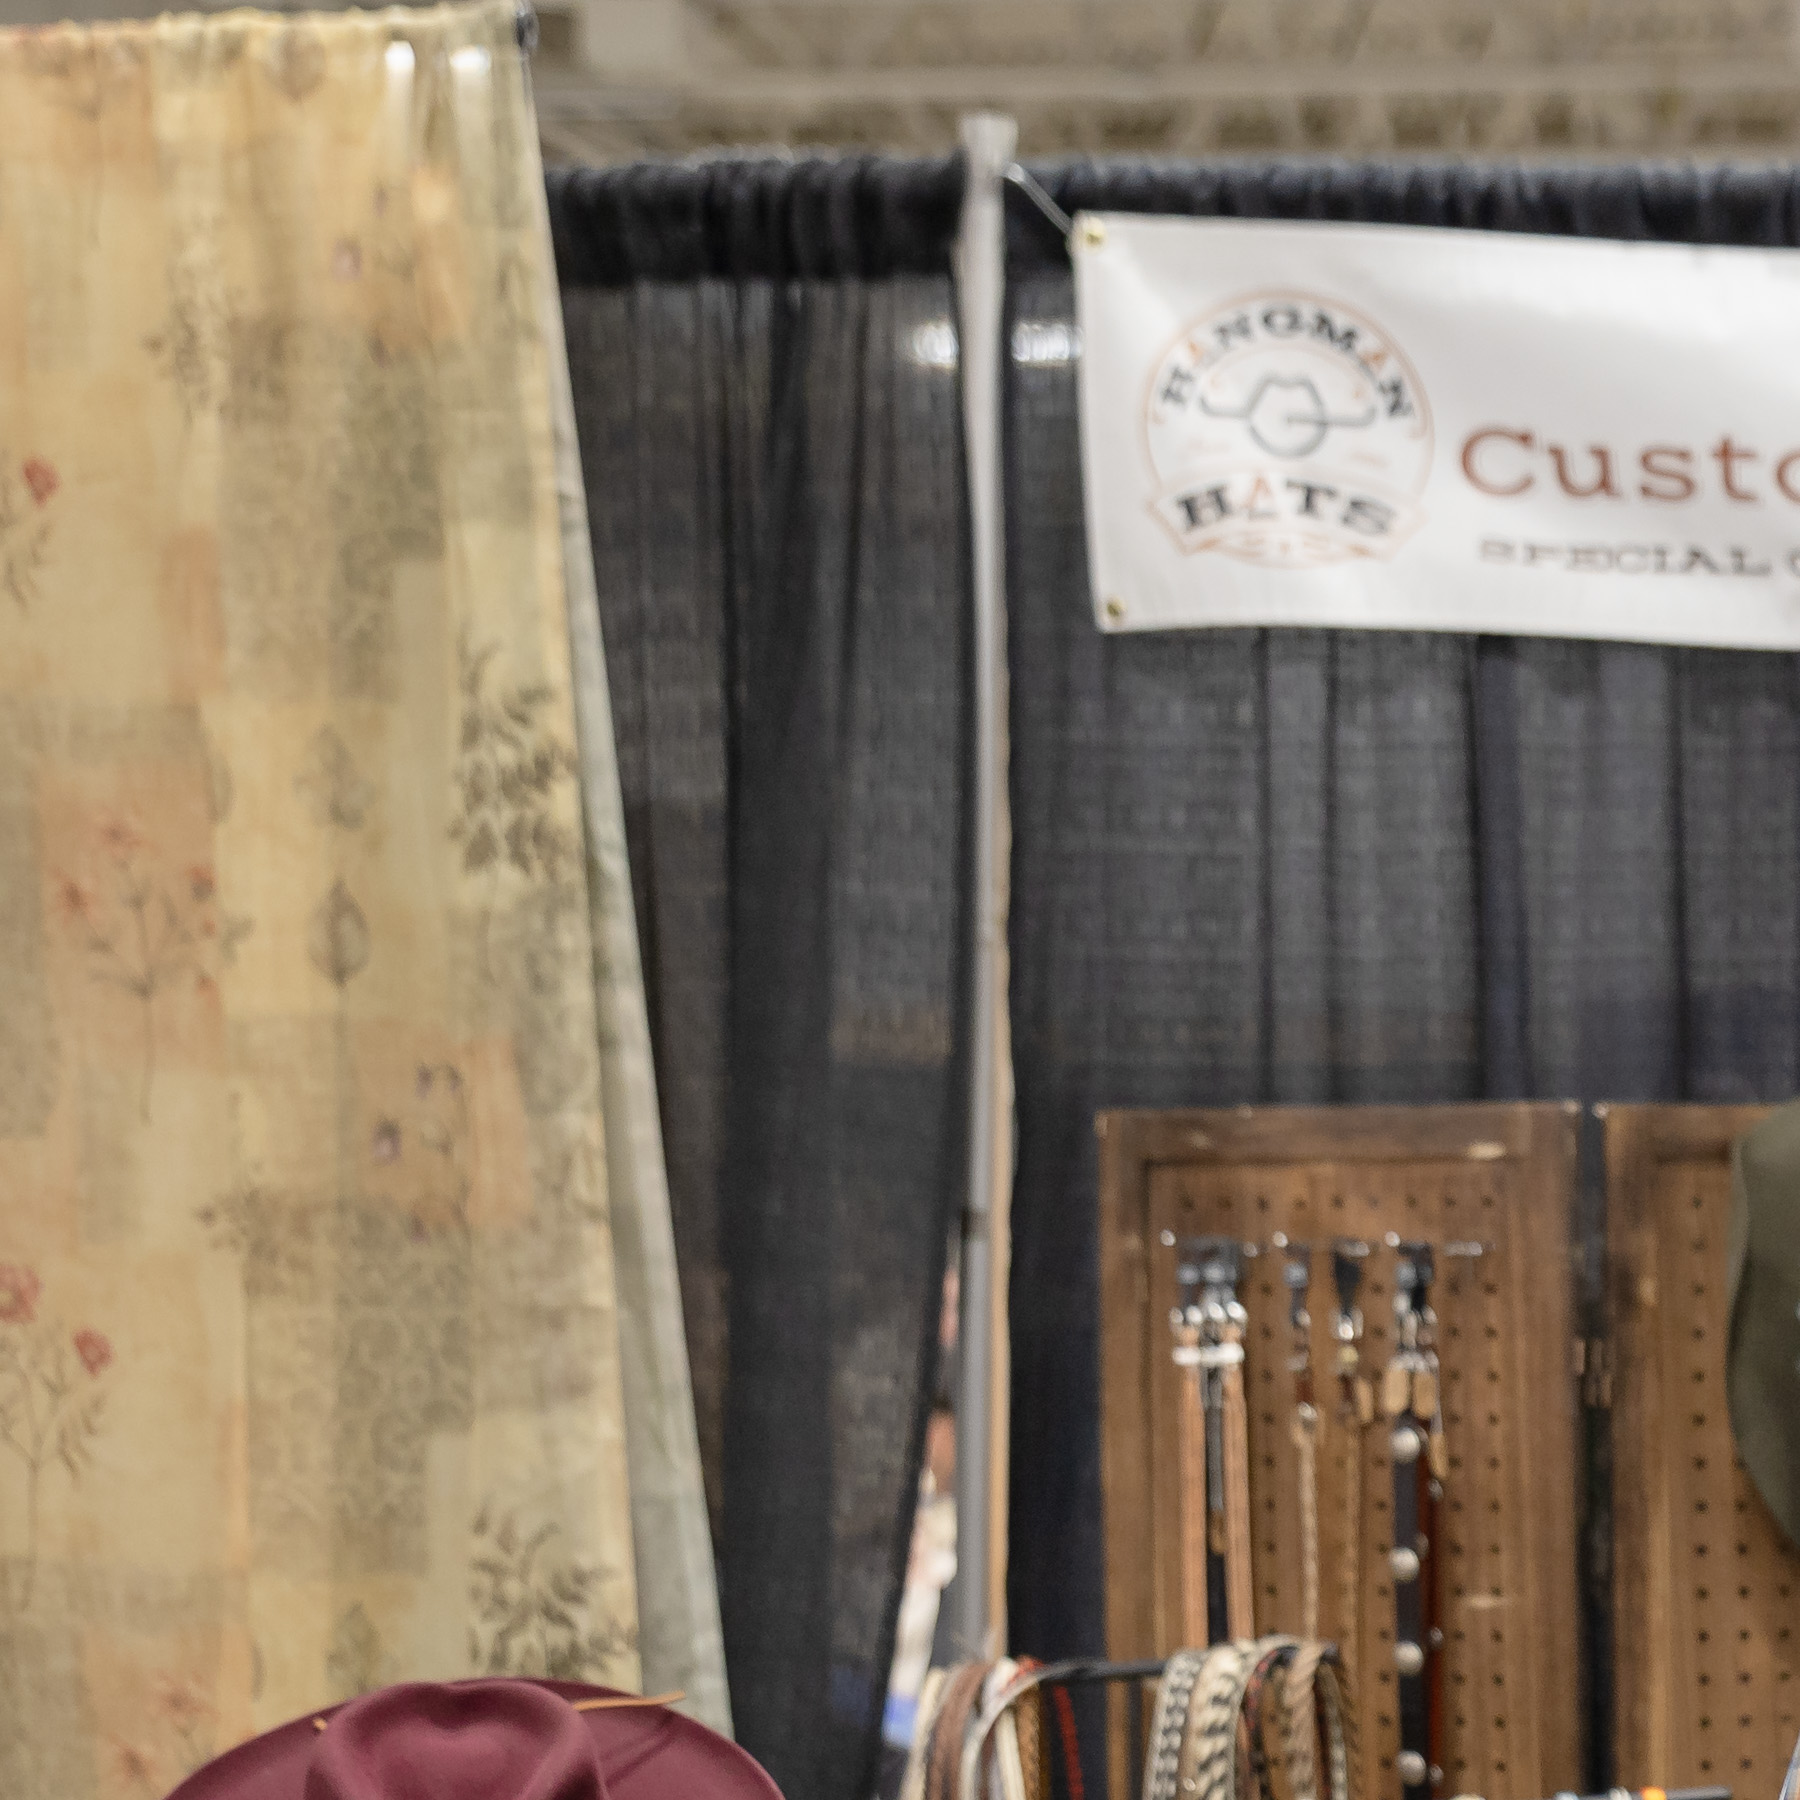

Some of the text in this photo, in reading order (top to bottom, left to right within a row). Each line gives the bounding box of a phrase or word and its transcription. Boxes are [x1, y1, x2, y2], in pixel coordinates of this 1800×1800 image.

[1160, 304, 1414, 418] HANGMAN
[1176, 474, 1397, 537] HATS
[1479, 537, 1773, 578] SPECIAL
